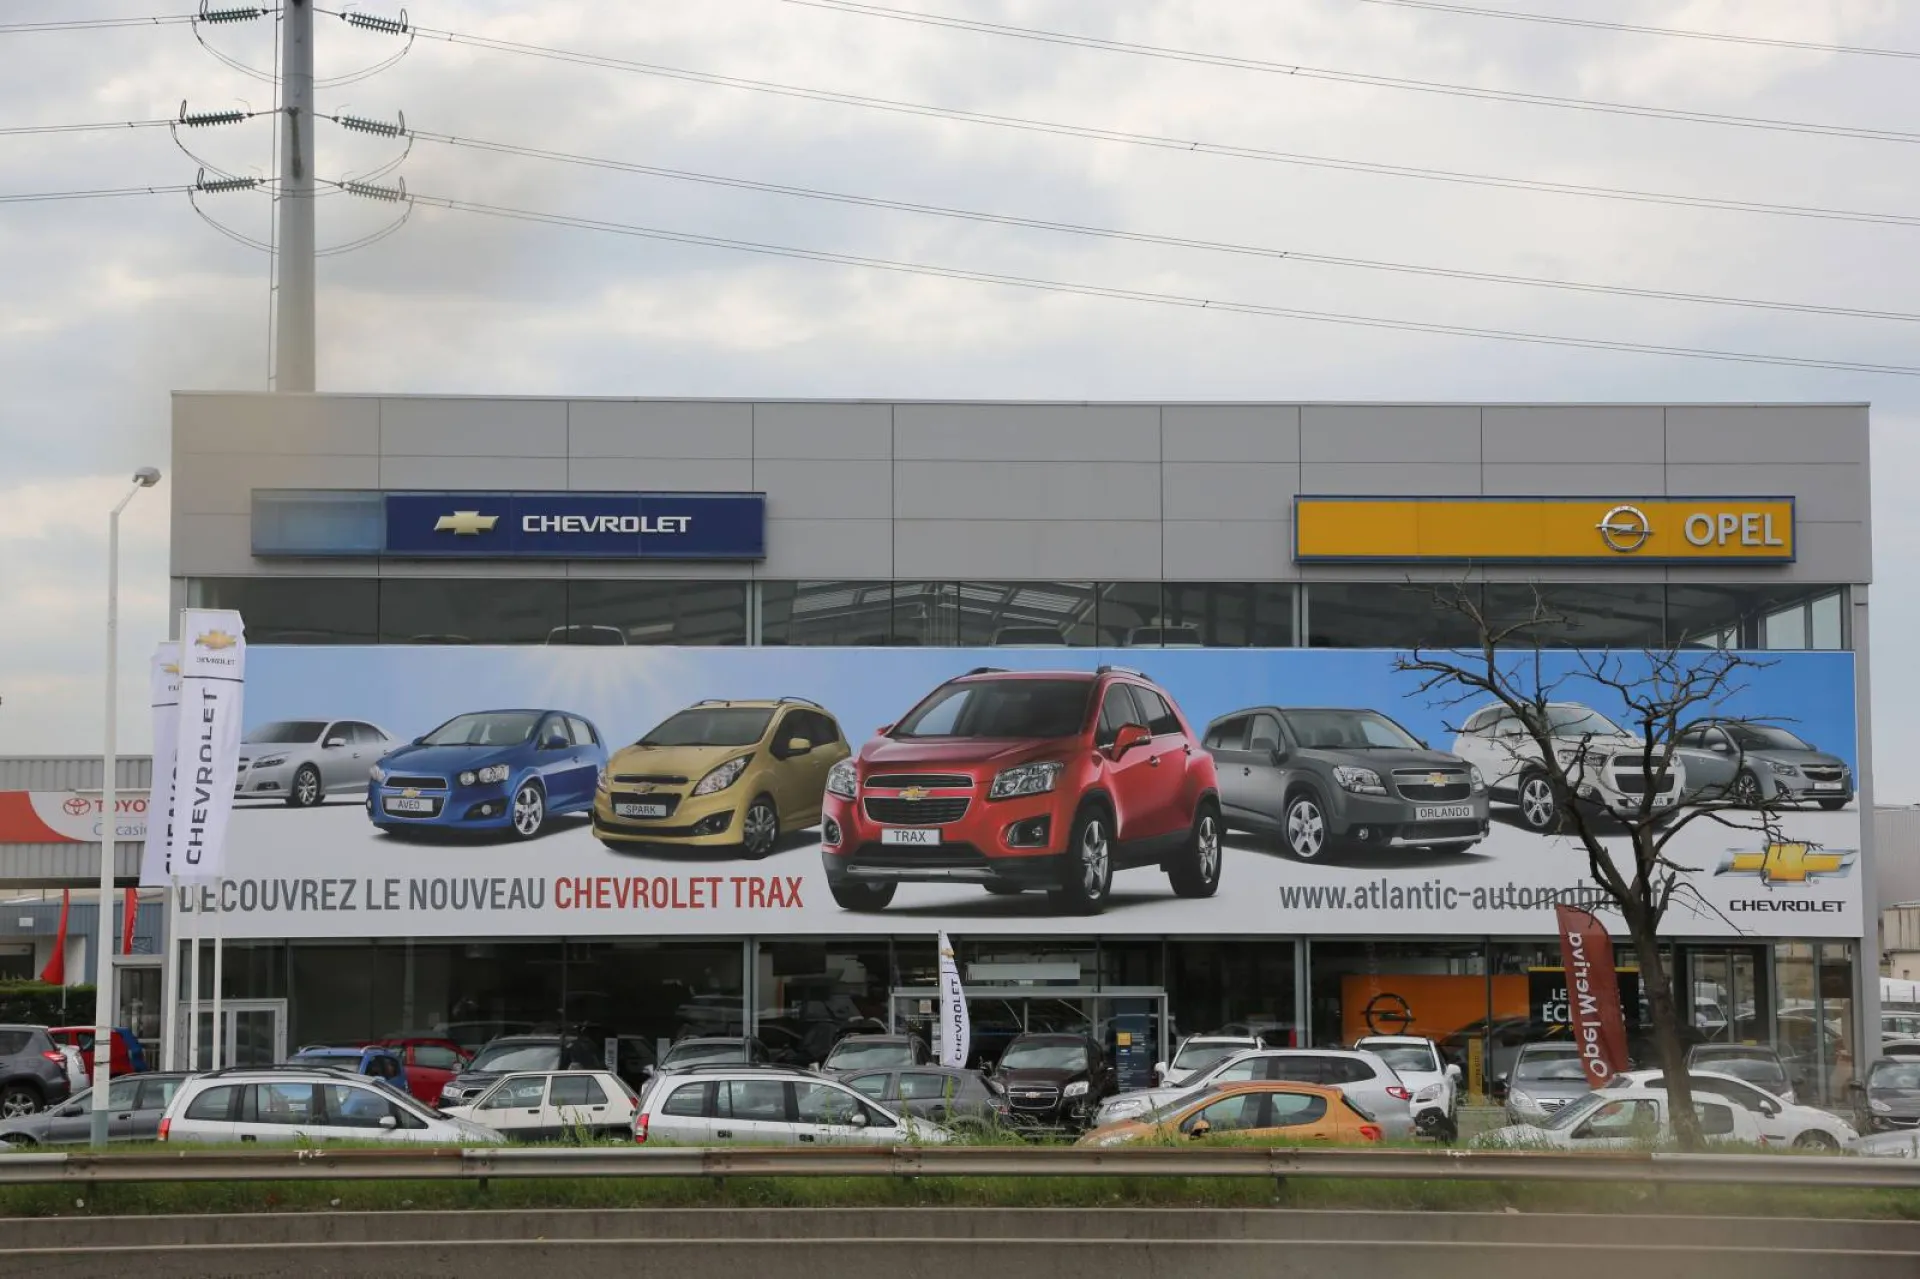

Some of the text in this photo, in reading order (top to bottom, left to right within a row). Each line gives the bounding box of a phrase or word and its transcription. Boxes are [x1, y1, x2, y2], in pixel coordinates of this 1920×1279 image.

[522, 515, 692, 533] CHEVROLET
[1684, 512, 1784, 546] OPEL
[186, 687, 217, 865] CHEVROLET
[397, 800, 420, 810] AVEO
[625, 804, 656, 815] SPARK
[1420, 806, 1470, 818] ORLANDO
[894, 830, 926, 842] TRAX
[366, 878, 400, 910] LE
[409, 877, 545, 910] NOUVEAU
[554, 876, 724, 909] CHEVROLET
[729, 876, 804, 908] TRAX
[1729, 900, 1846, 912] CHEVROLET
[951, 978, 963, 1062] CHEVROLET
